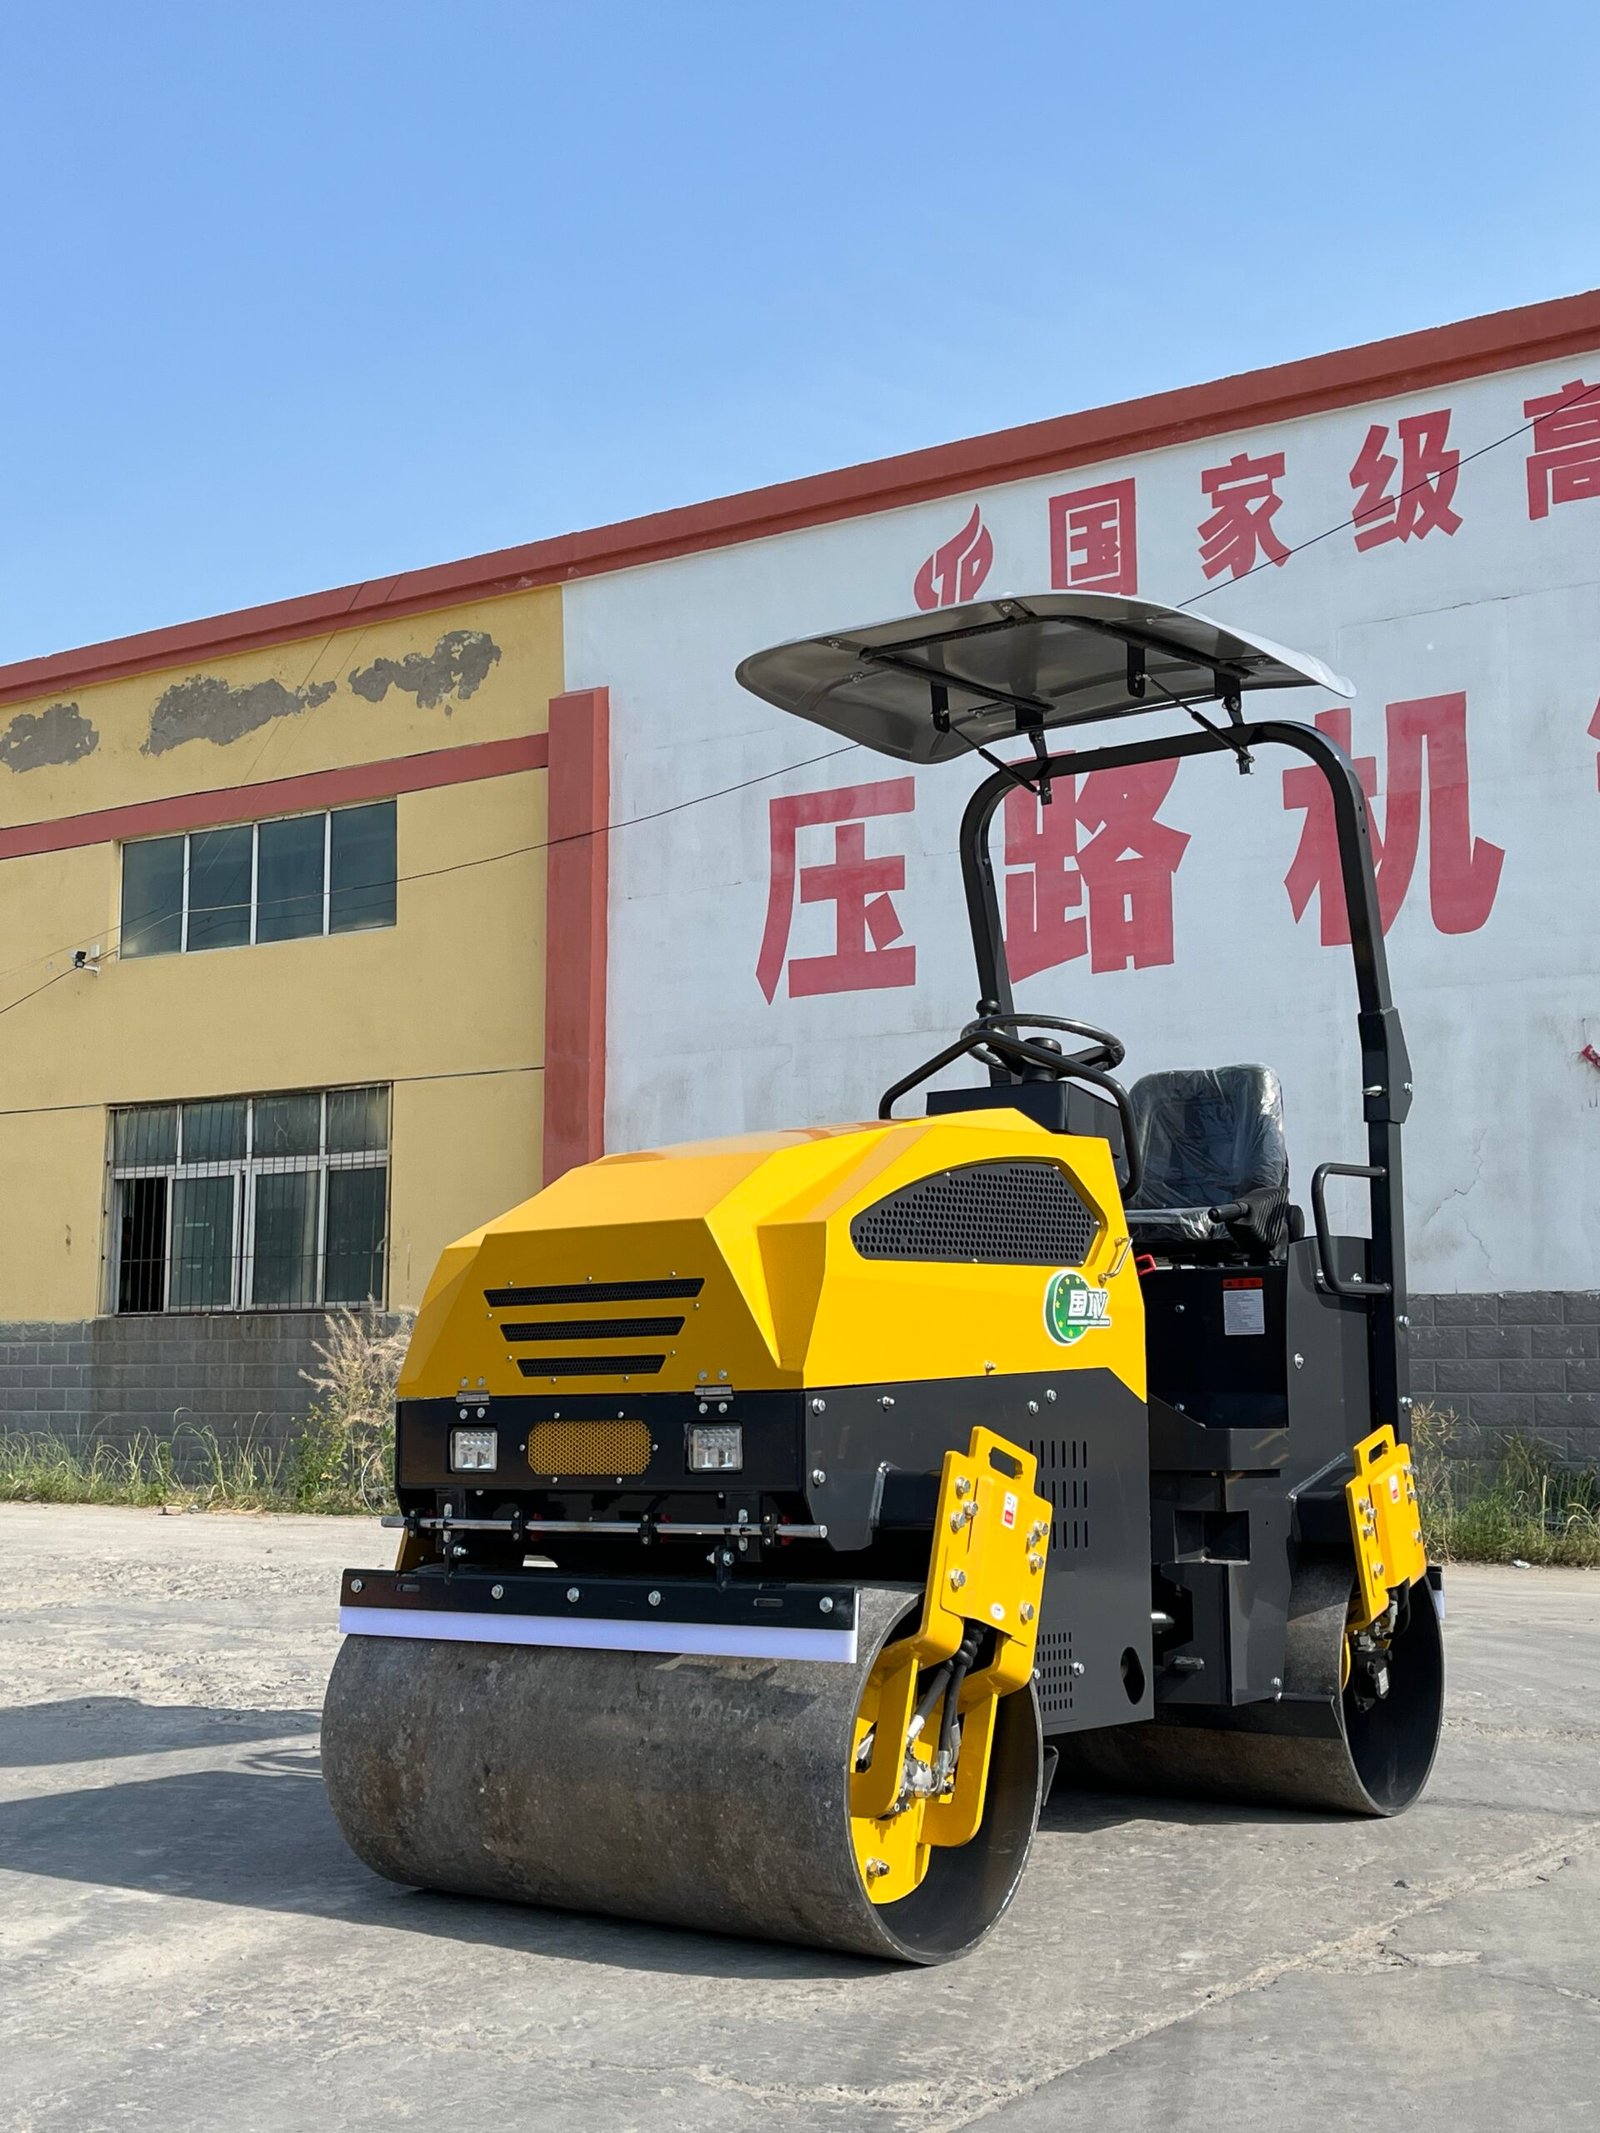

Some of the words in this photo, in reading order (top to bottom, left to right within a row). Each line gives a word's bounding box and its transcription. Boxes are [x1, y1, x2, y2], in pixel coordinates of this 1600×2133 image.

[1049, 379, 1600, 596] 国家级高
[755, 690, 1600, 1005] 压路机
